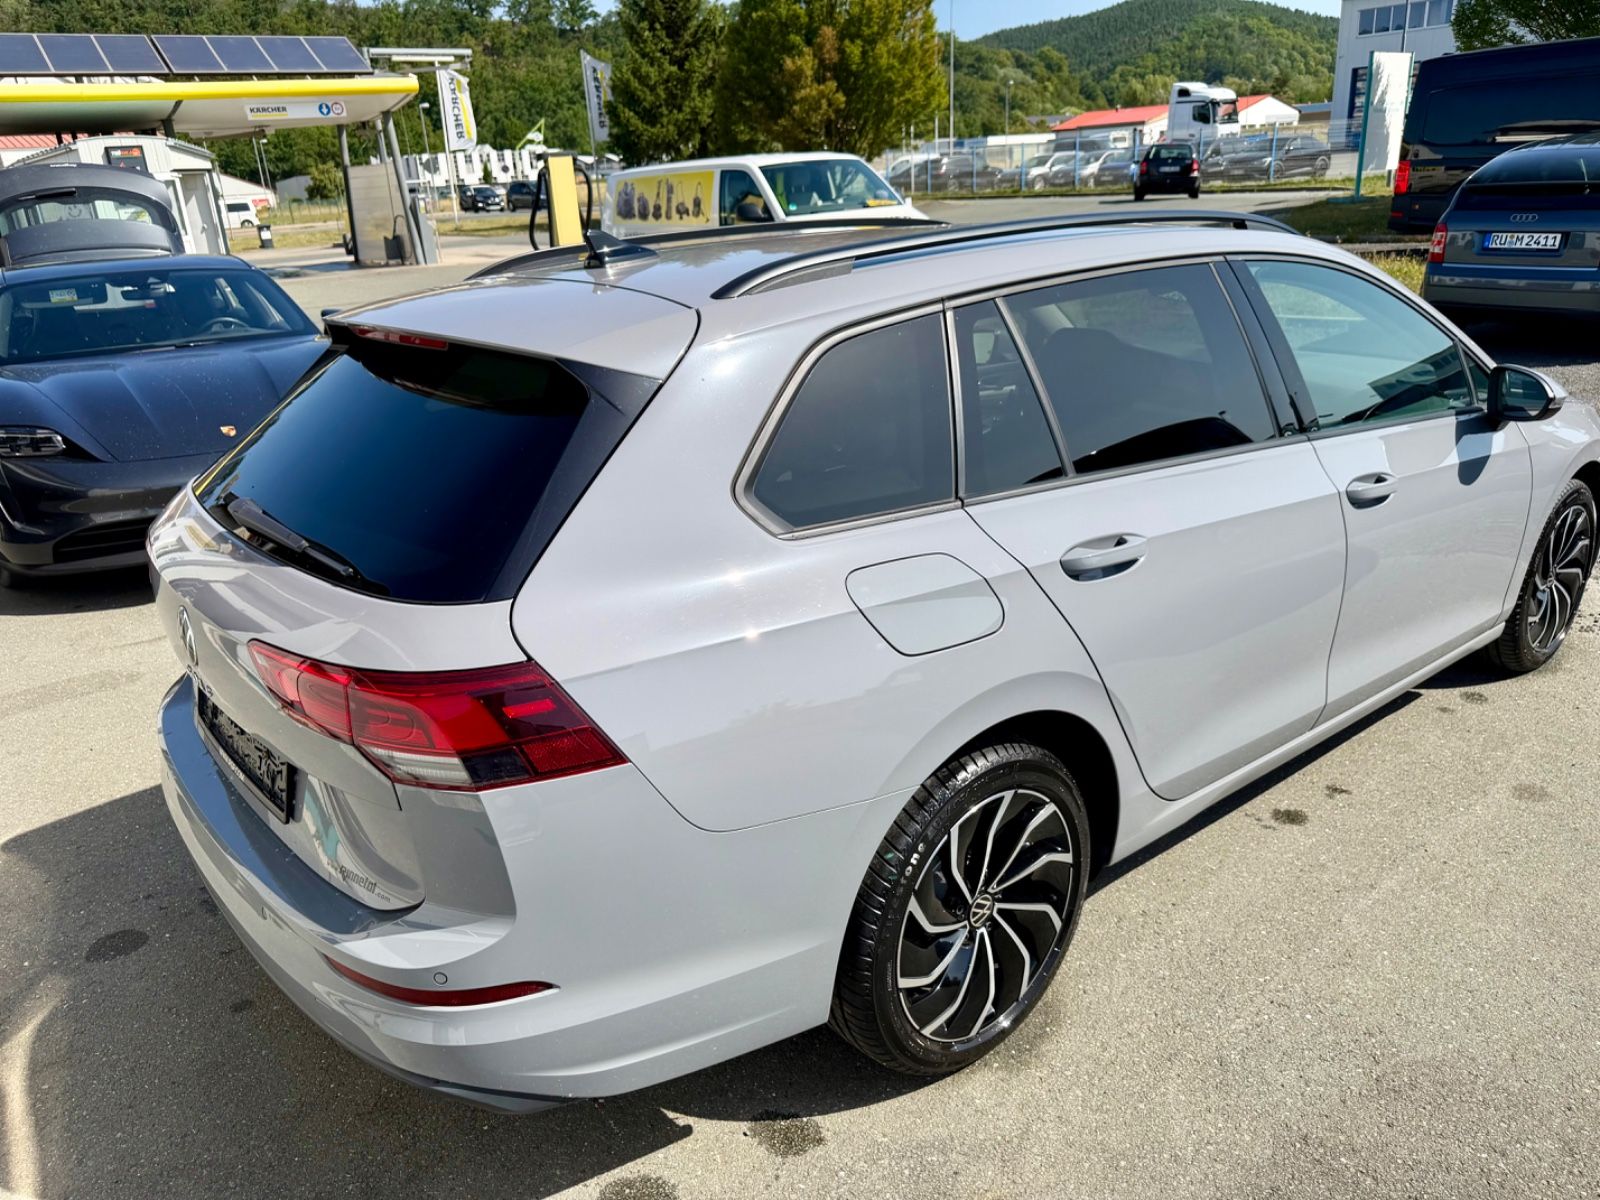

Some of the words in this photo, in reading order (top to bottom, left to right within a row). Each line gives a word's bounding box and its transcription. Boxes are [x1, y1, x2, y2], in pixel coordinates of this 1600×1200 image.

[1490, 234, 1508, 246] RU
[1515, 235, 1525, 247] M
[1525, 234, 1558, 248] 2411
